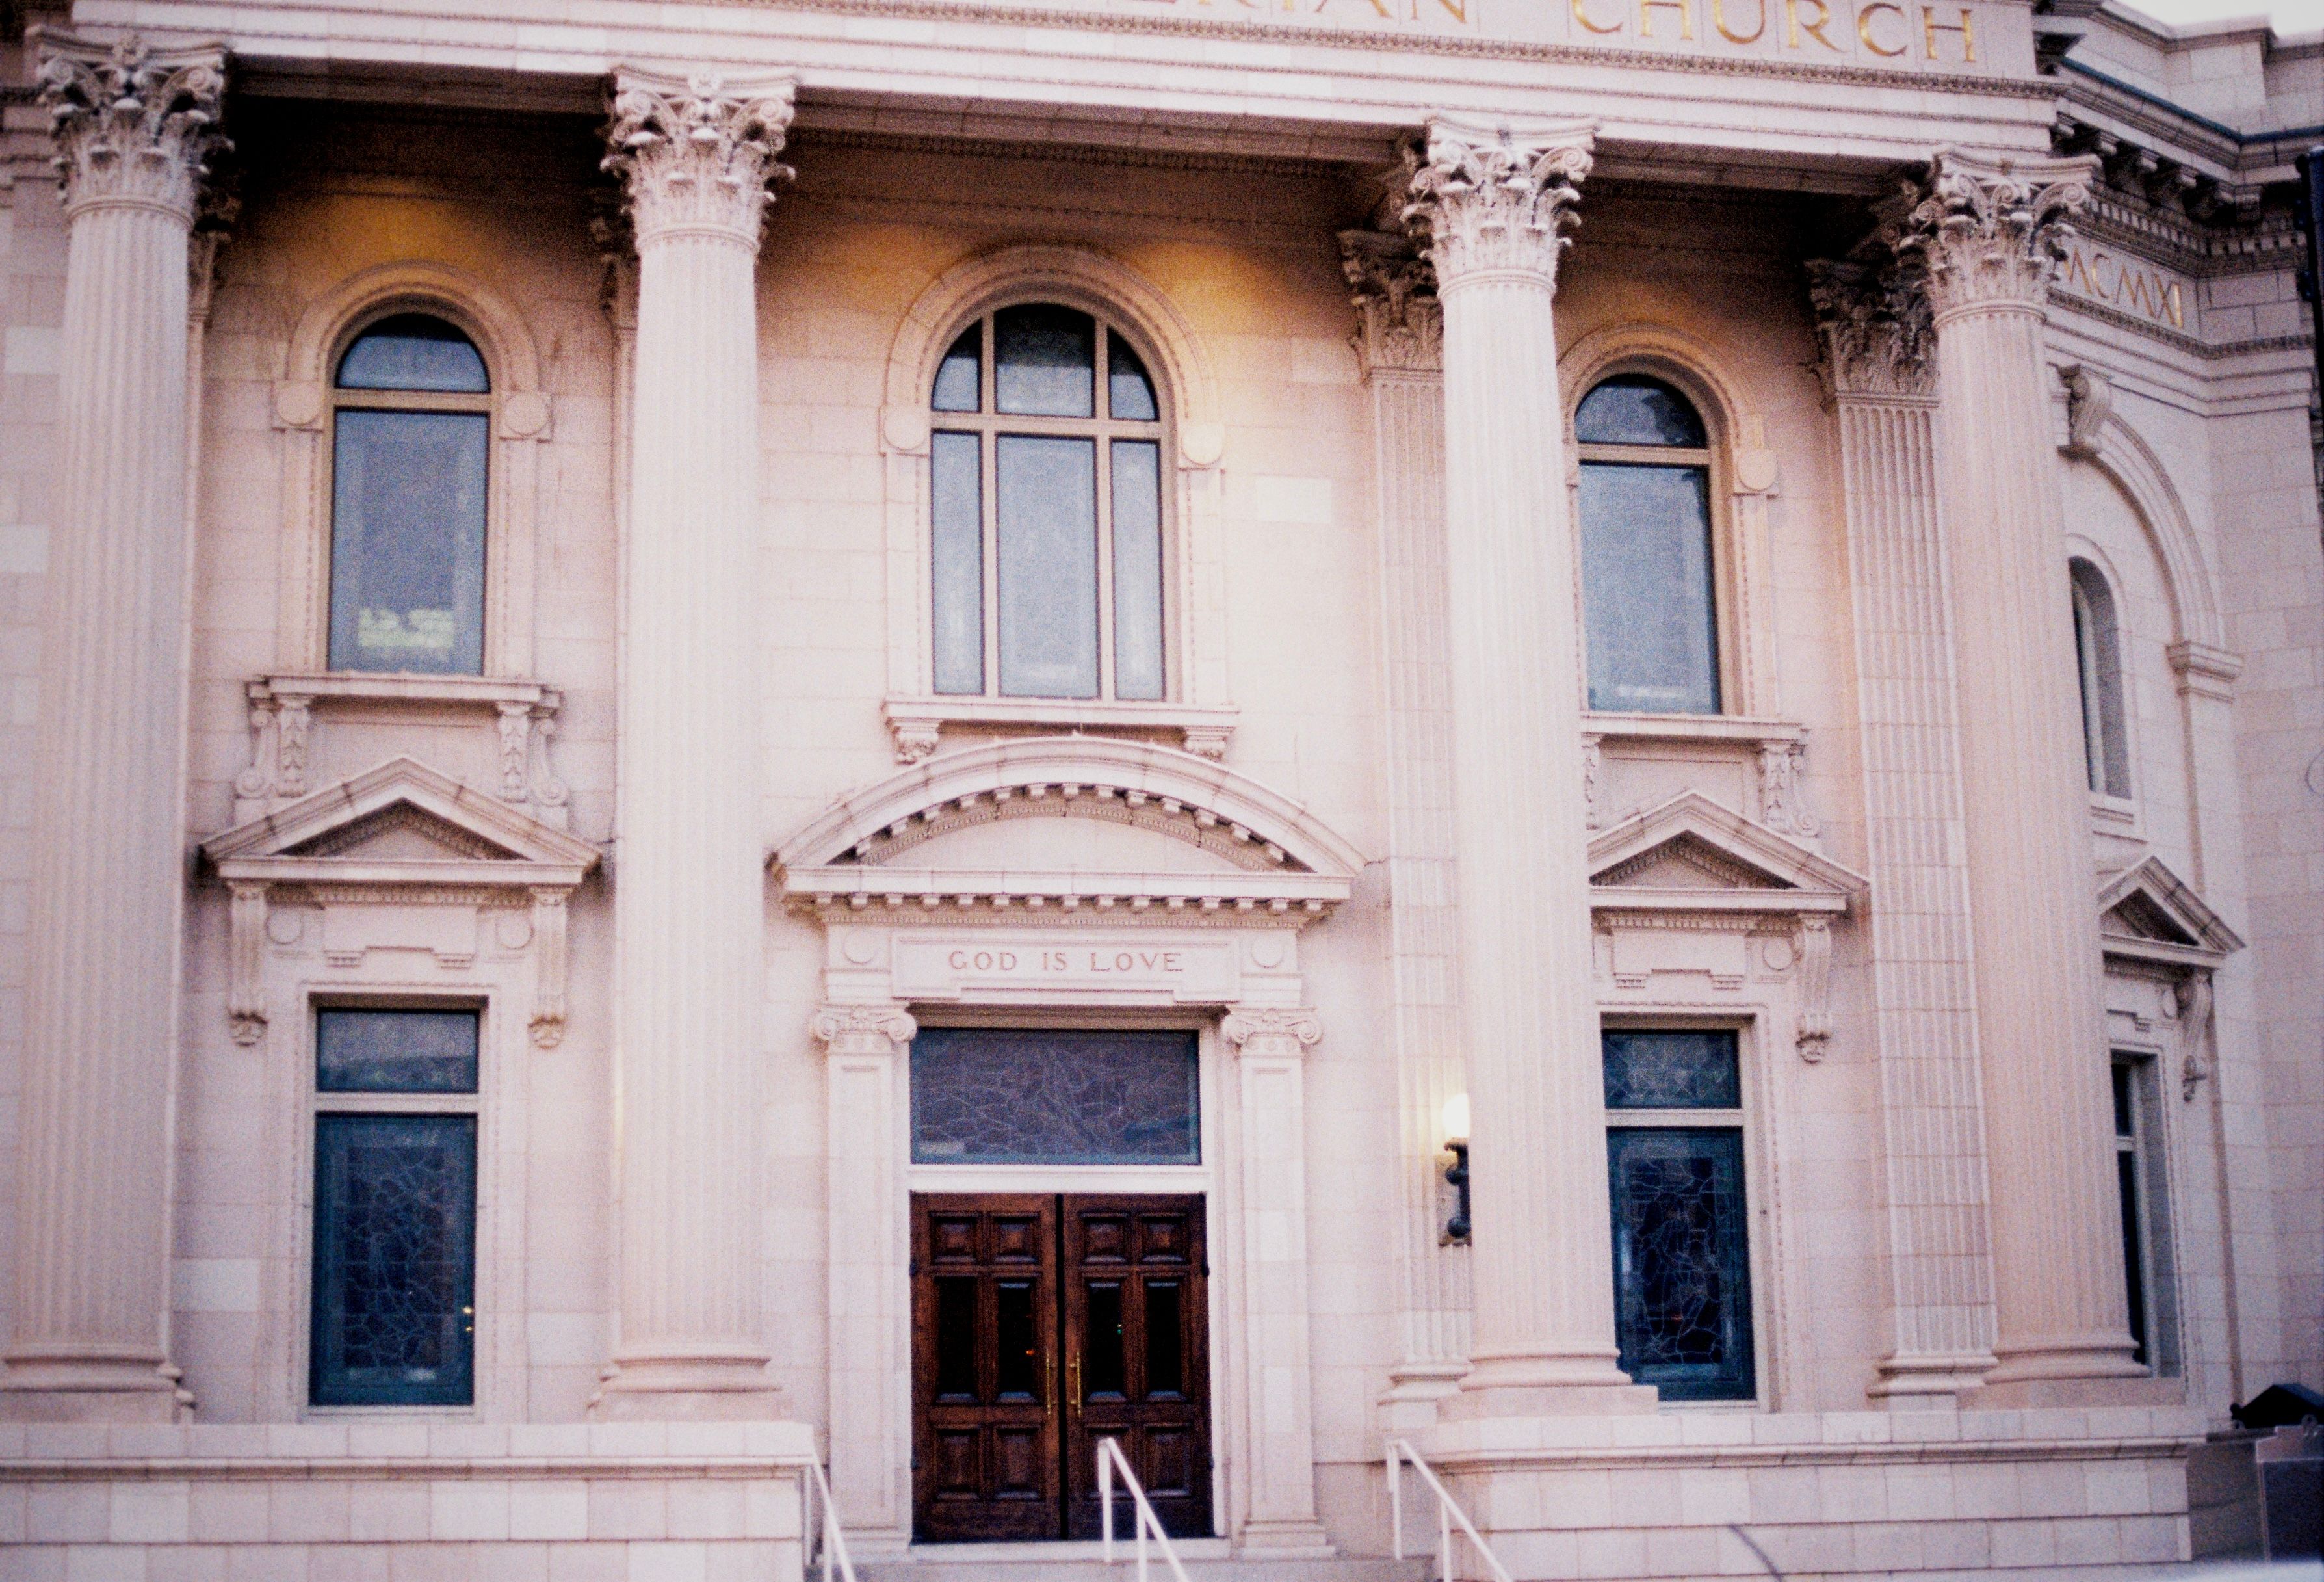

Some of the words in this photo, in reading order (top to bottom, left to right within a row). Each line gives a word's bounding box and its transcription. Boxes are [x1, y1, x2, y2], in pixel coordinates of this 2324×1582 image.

[1571, 0, 1976, 62] CHURCH
[948, 951, 1017, 971] GOD
[1043, 952, 1068, 971] IS
[1090, 952, 1184, 972] LOVE
